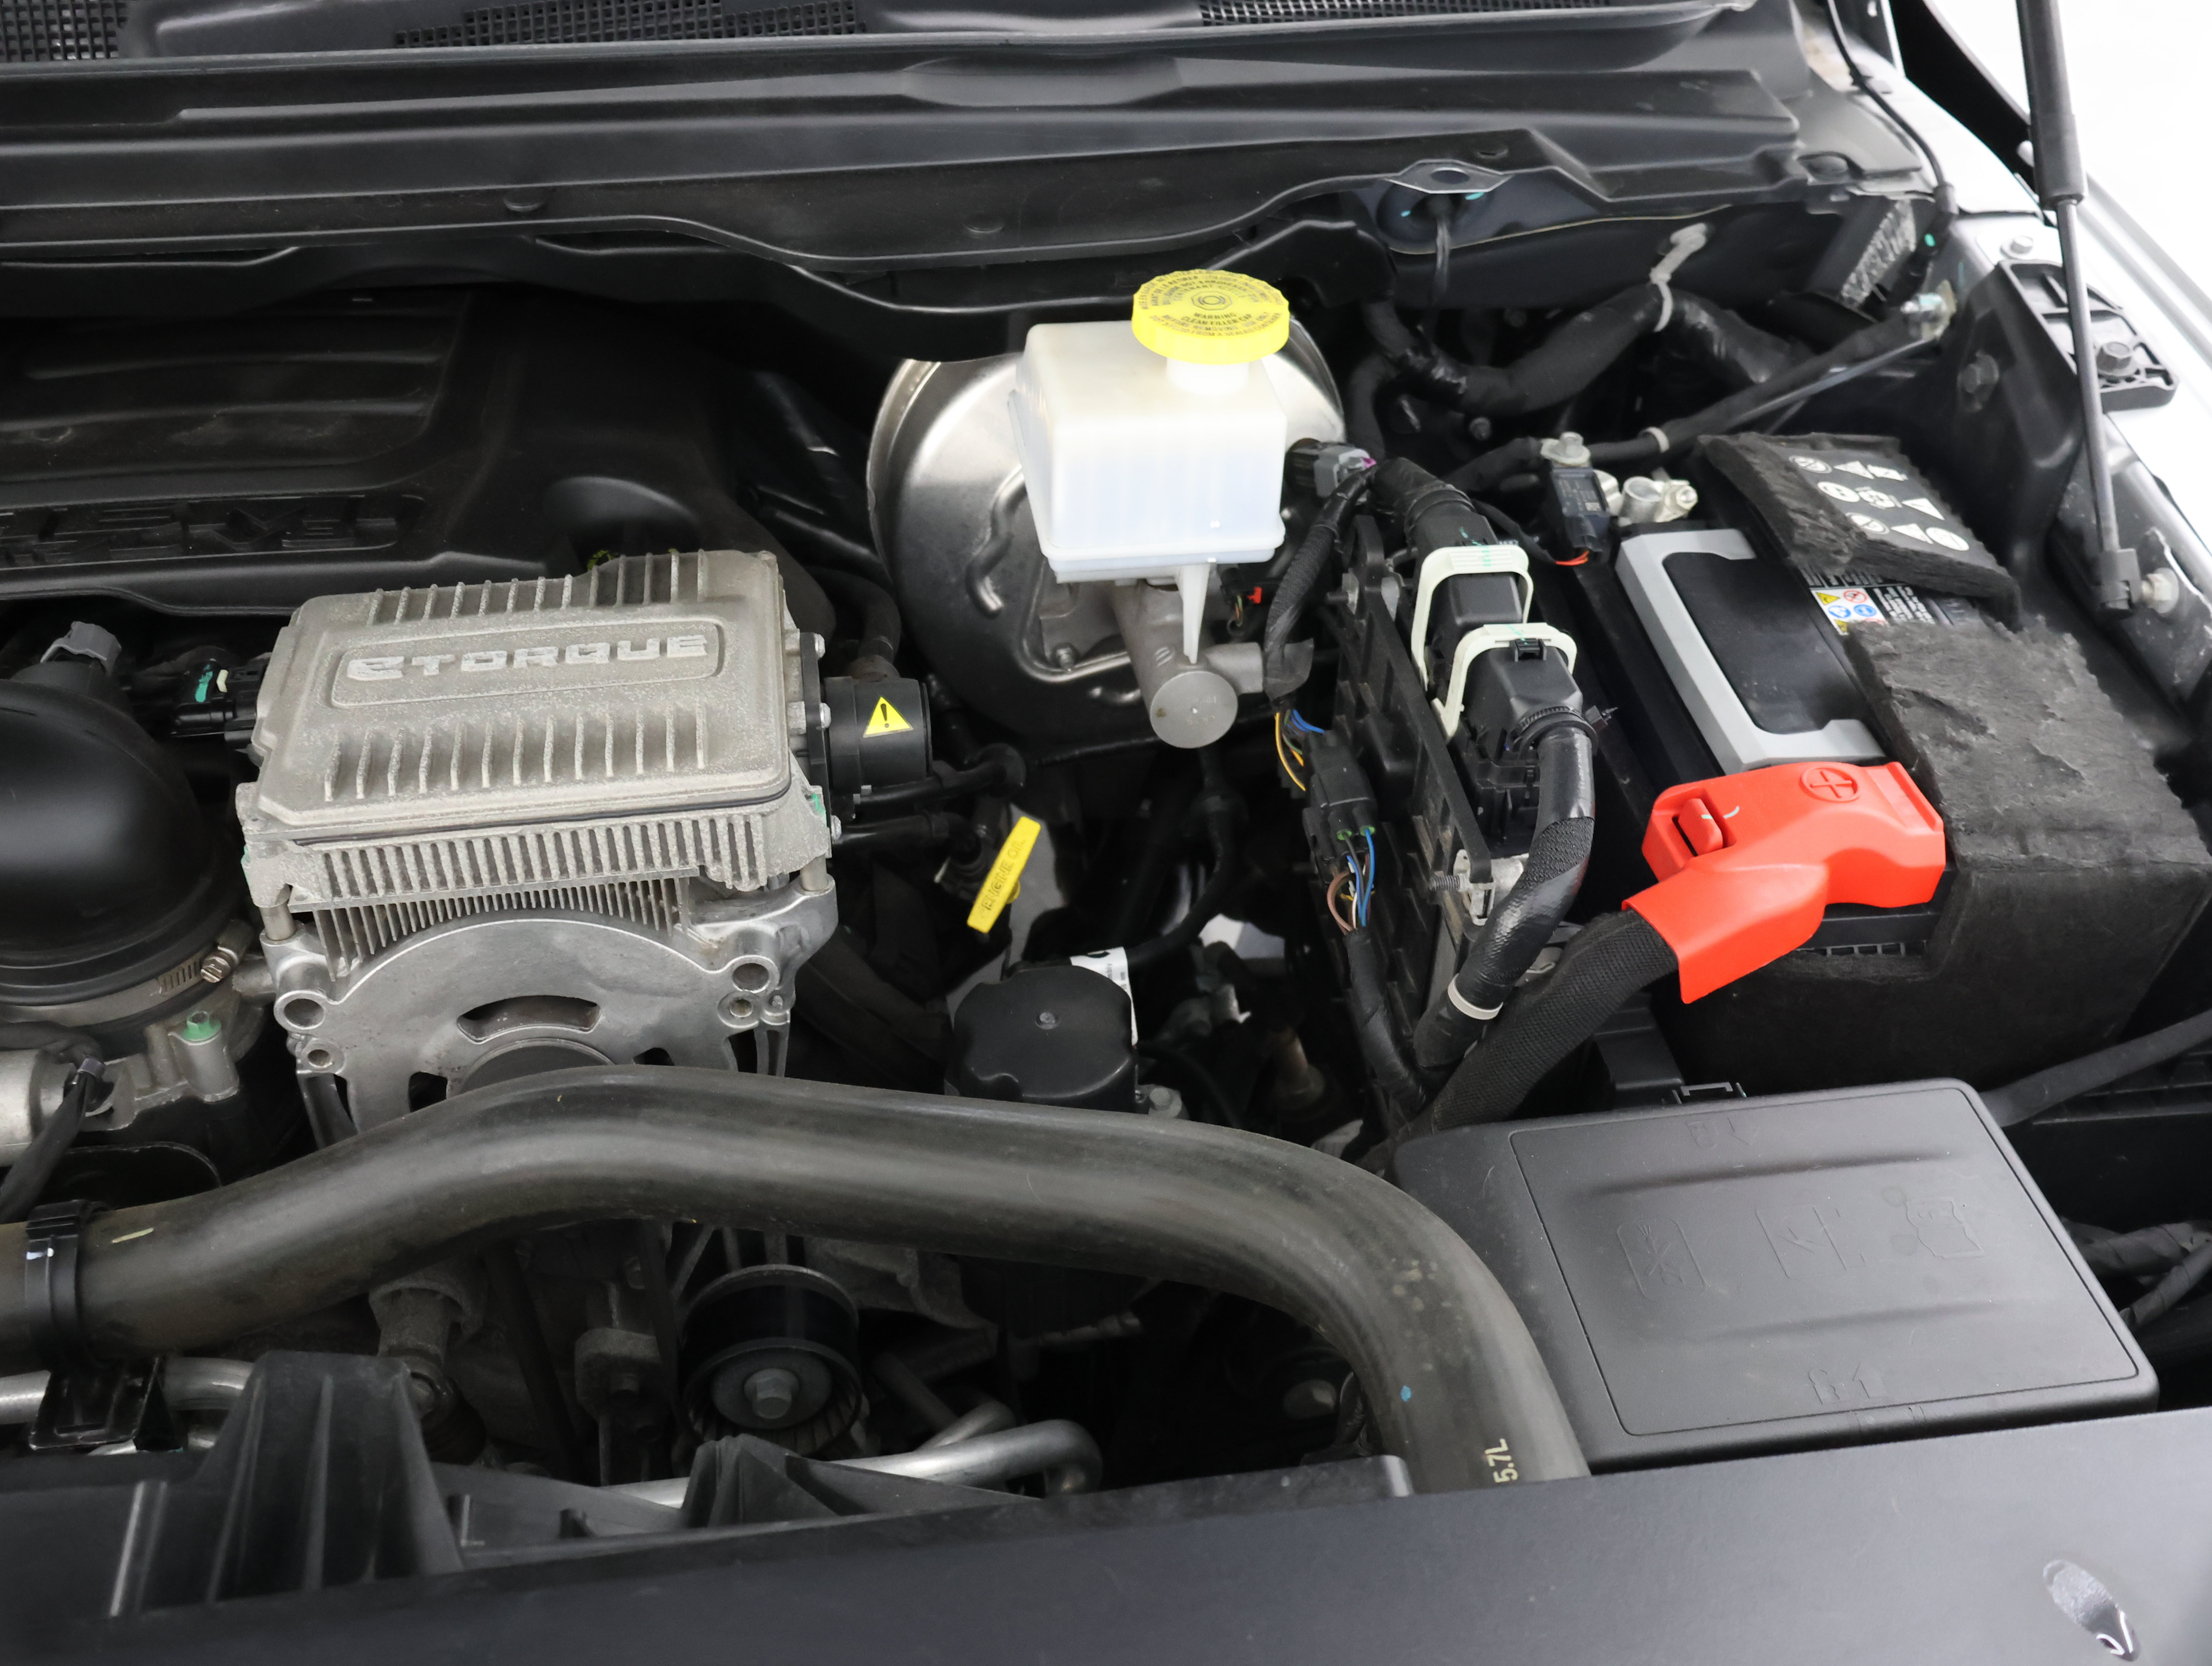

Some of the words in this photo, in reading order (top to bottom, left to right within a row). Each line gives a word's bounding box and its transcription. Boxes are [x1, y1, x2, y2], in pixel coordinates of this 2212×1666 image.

[982, 860, 1014, 911] ENGINE
[1007, 839, 1026, 860] OIL
[1485, 1438, 1519, 1483] 5.7L
